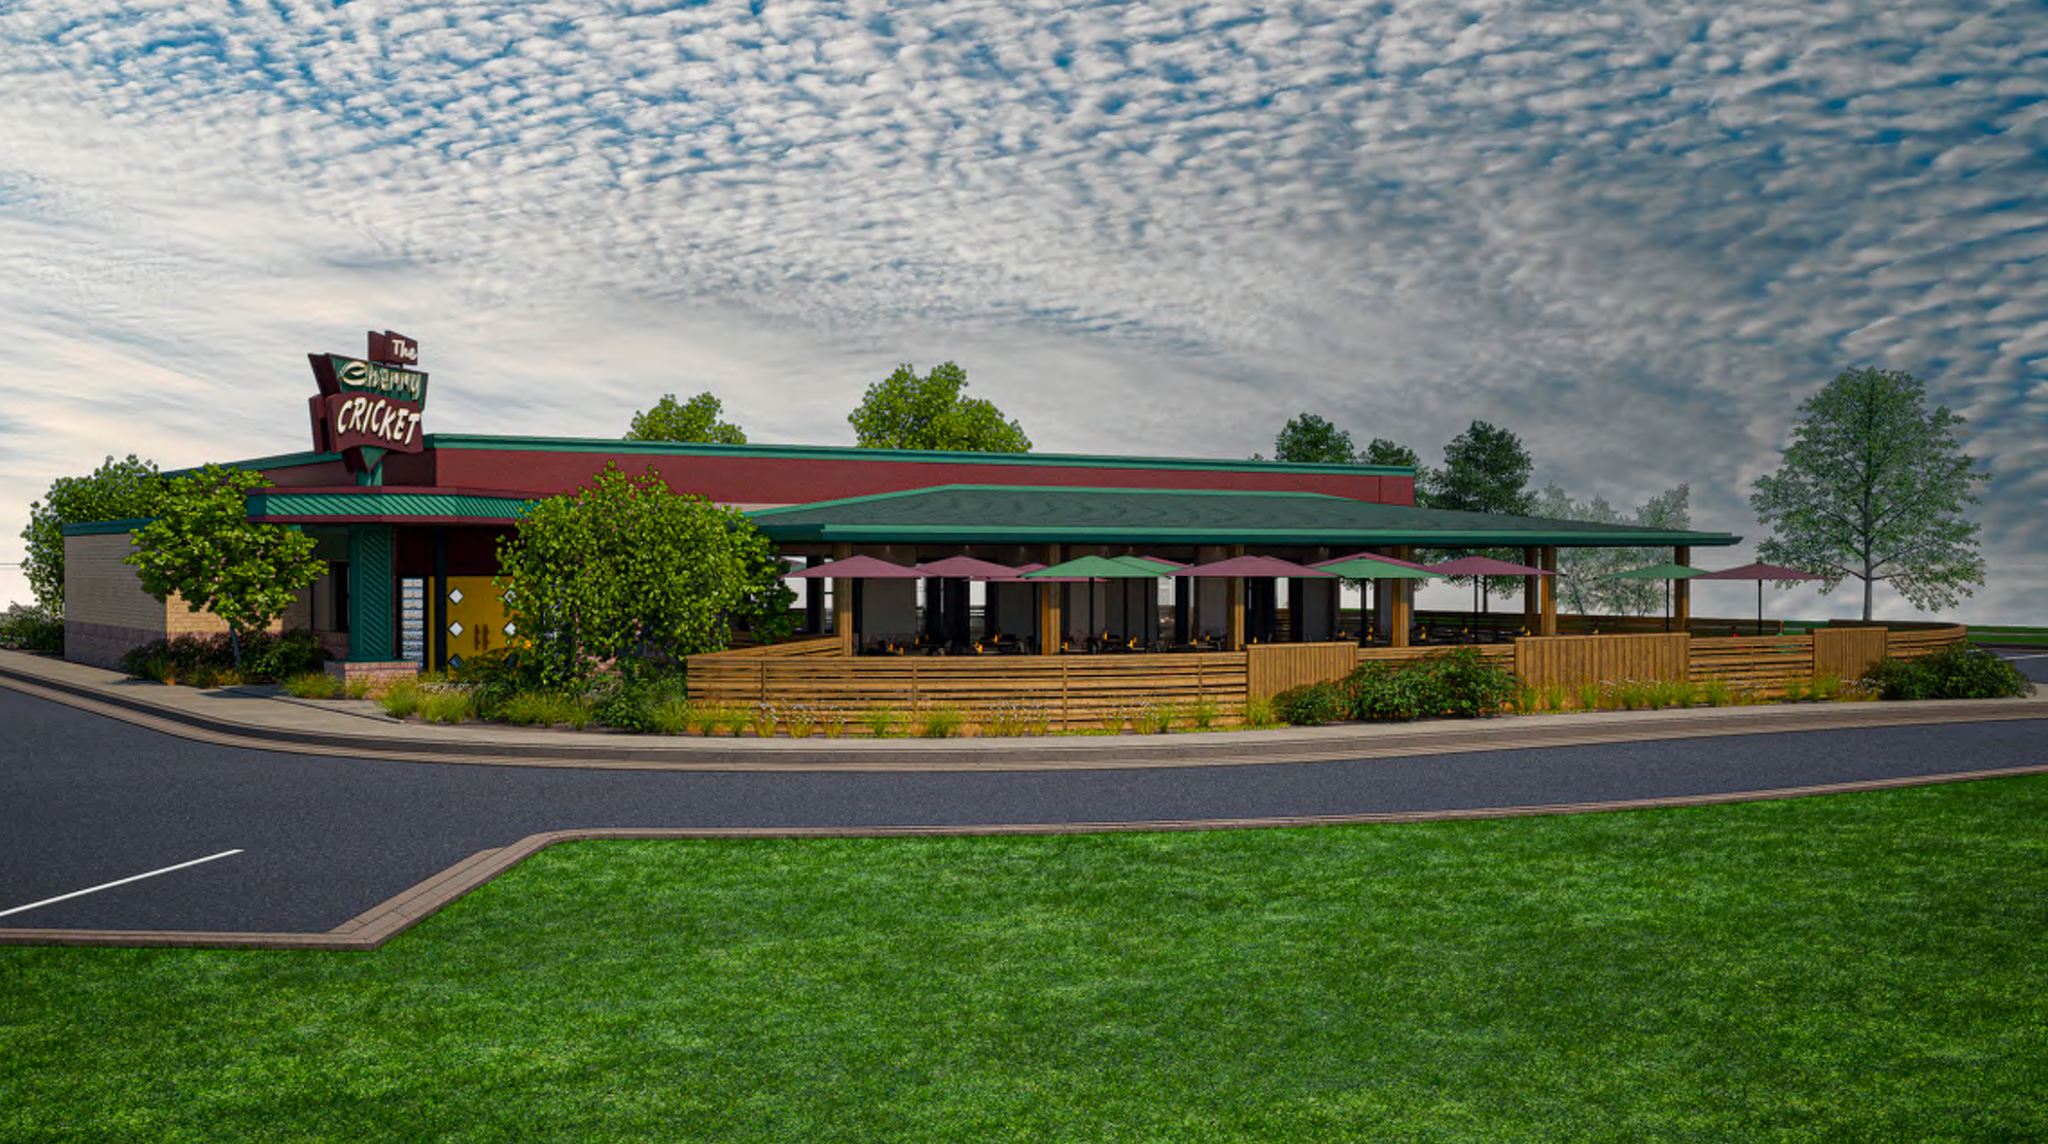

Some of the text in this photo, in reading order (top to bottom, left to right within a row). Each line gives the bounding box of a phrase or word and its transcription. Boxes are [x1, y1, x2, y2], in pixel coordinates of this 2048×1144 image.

[391, 339, 417, 360] The
[339, 361, 422, 400] Cherry
[337, 397, 421, 445] CRICKET
